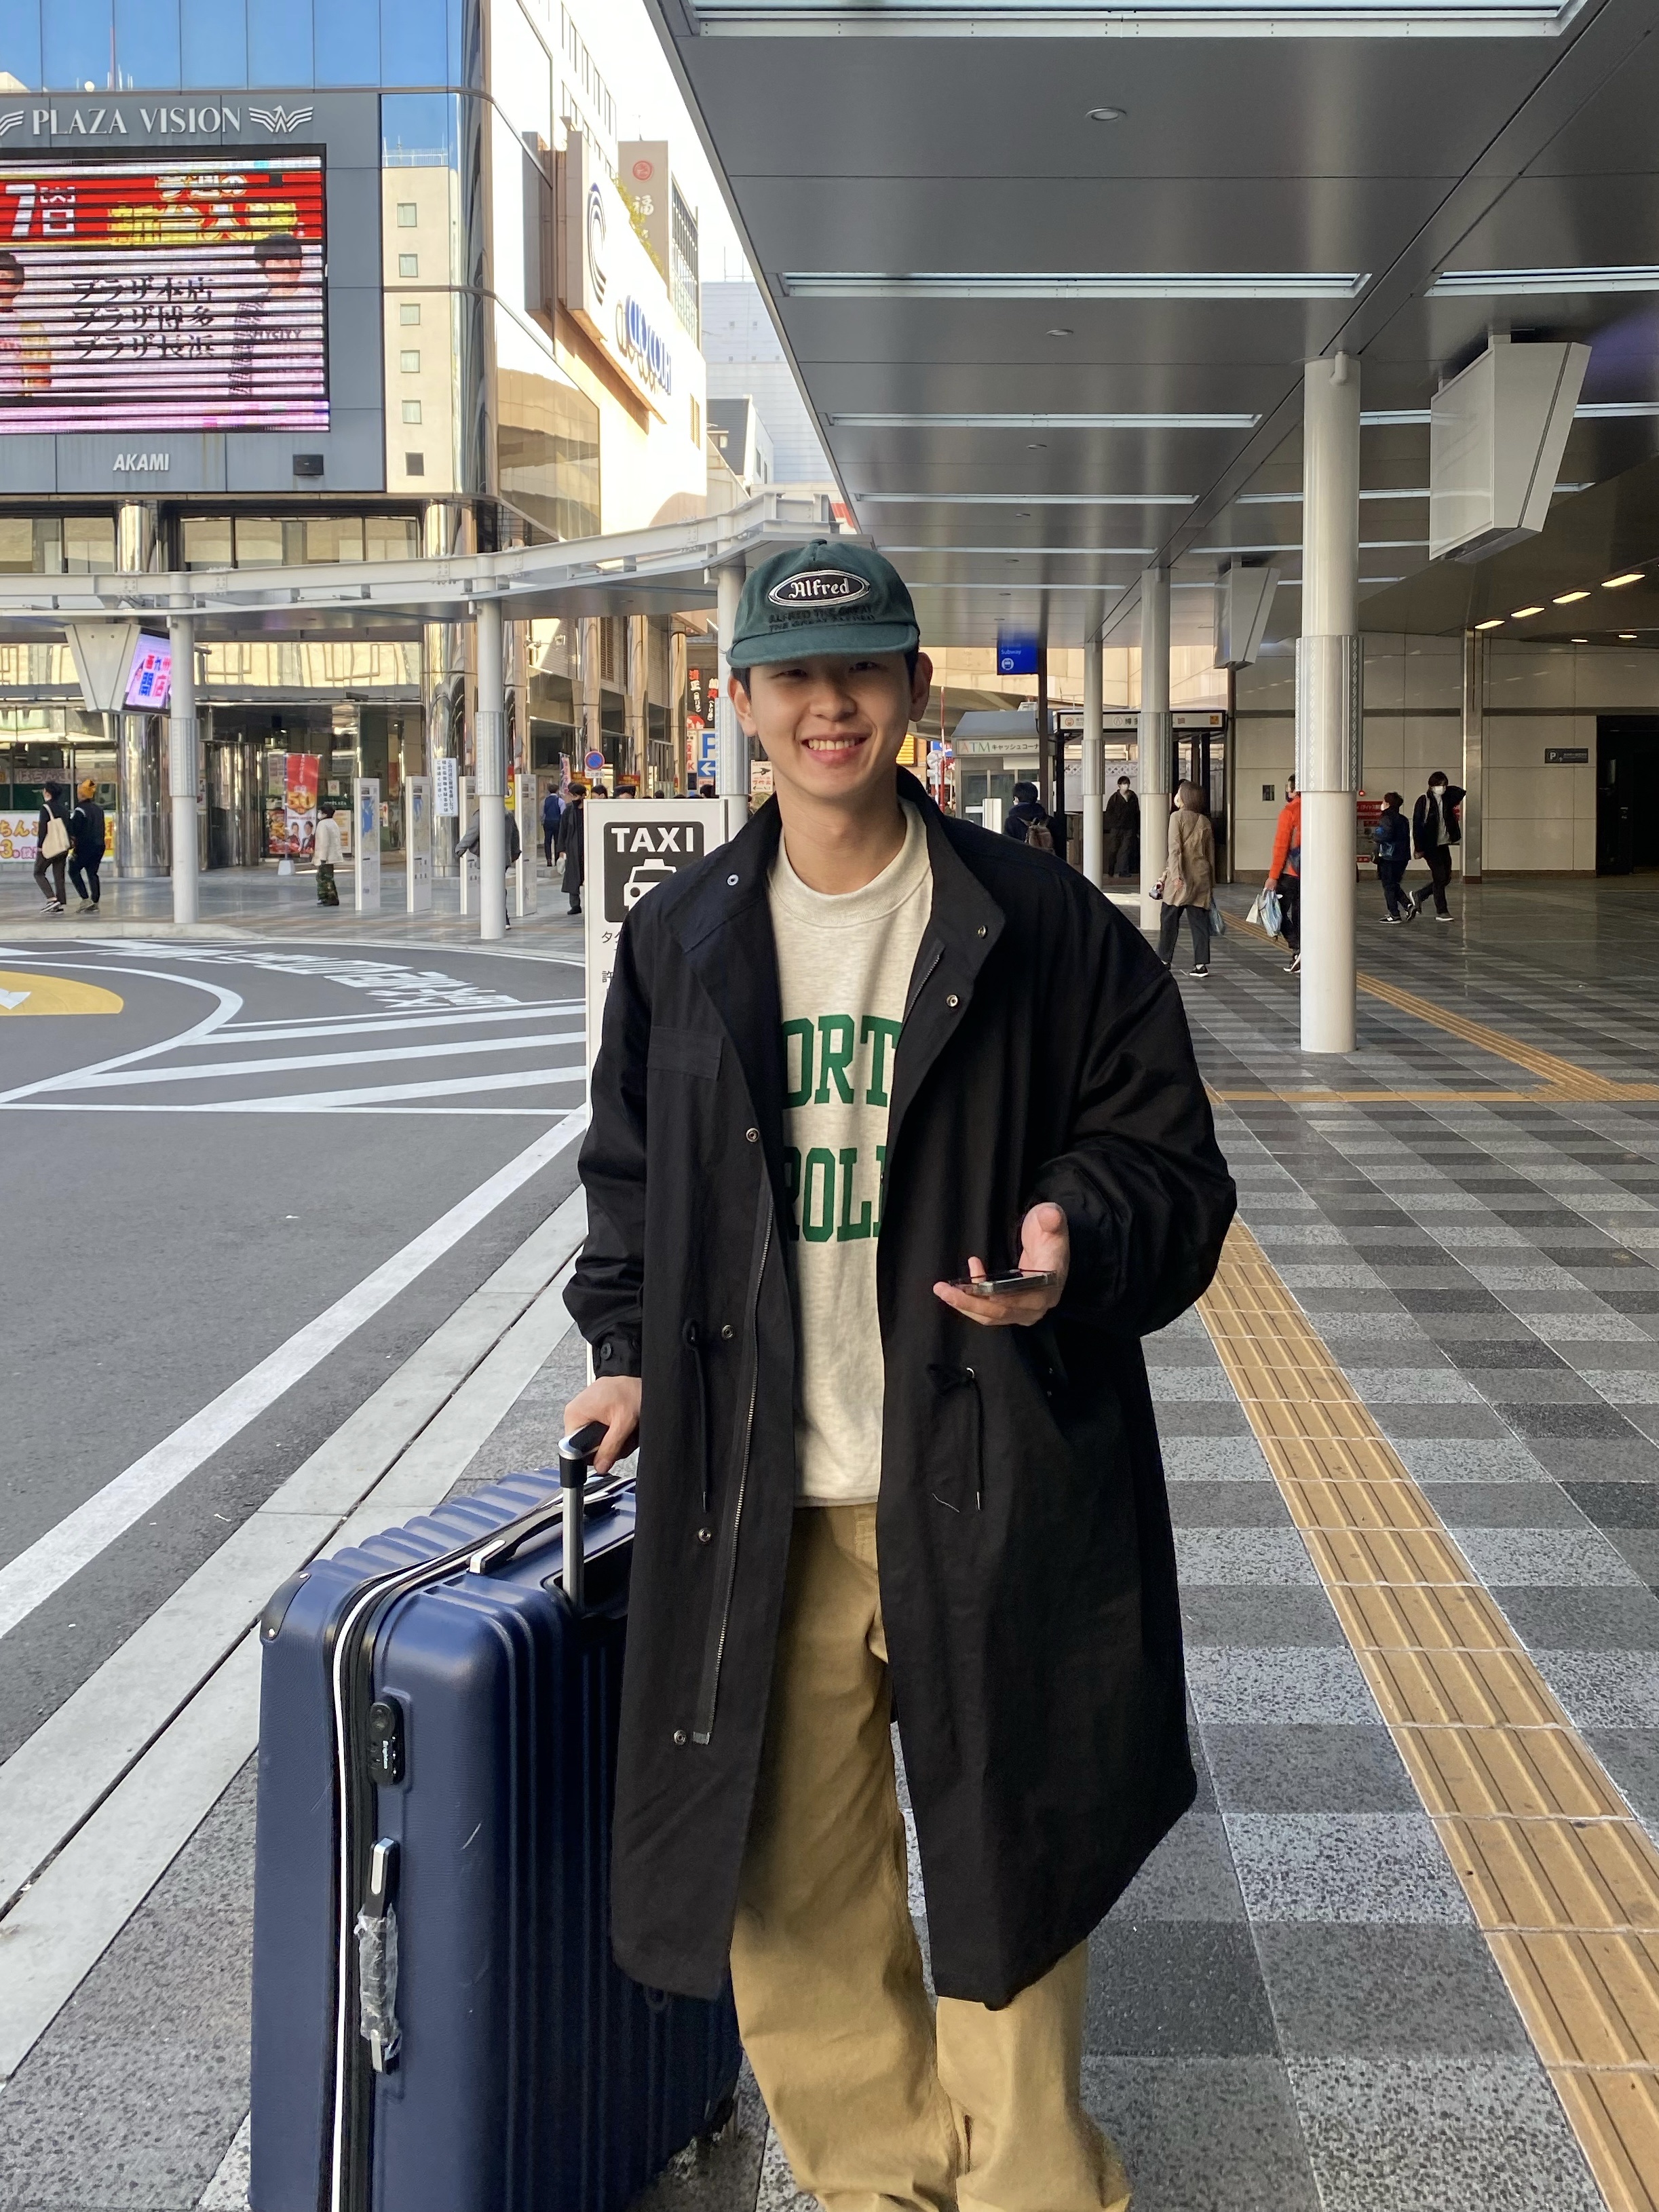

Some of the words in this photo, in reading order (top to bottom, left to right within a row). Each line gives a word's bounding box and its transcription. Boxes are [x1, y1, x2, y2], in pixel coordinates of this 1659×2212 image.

[33, 109, 128, 136] PLAZA
[139, 107, 242, 134] VISION
[71, 274, 213, 302] プラザ本店
[72, 305, 214, 331] プラザ博多
[113, 453, 170, 472] AKAMI
[788, 577, 850, 599] Alfred
[961, 742, 990, 752] ATM
[611, 826, 695, 853] TAXI
